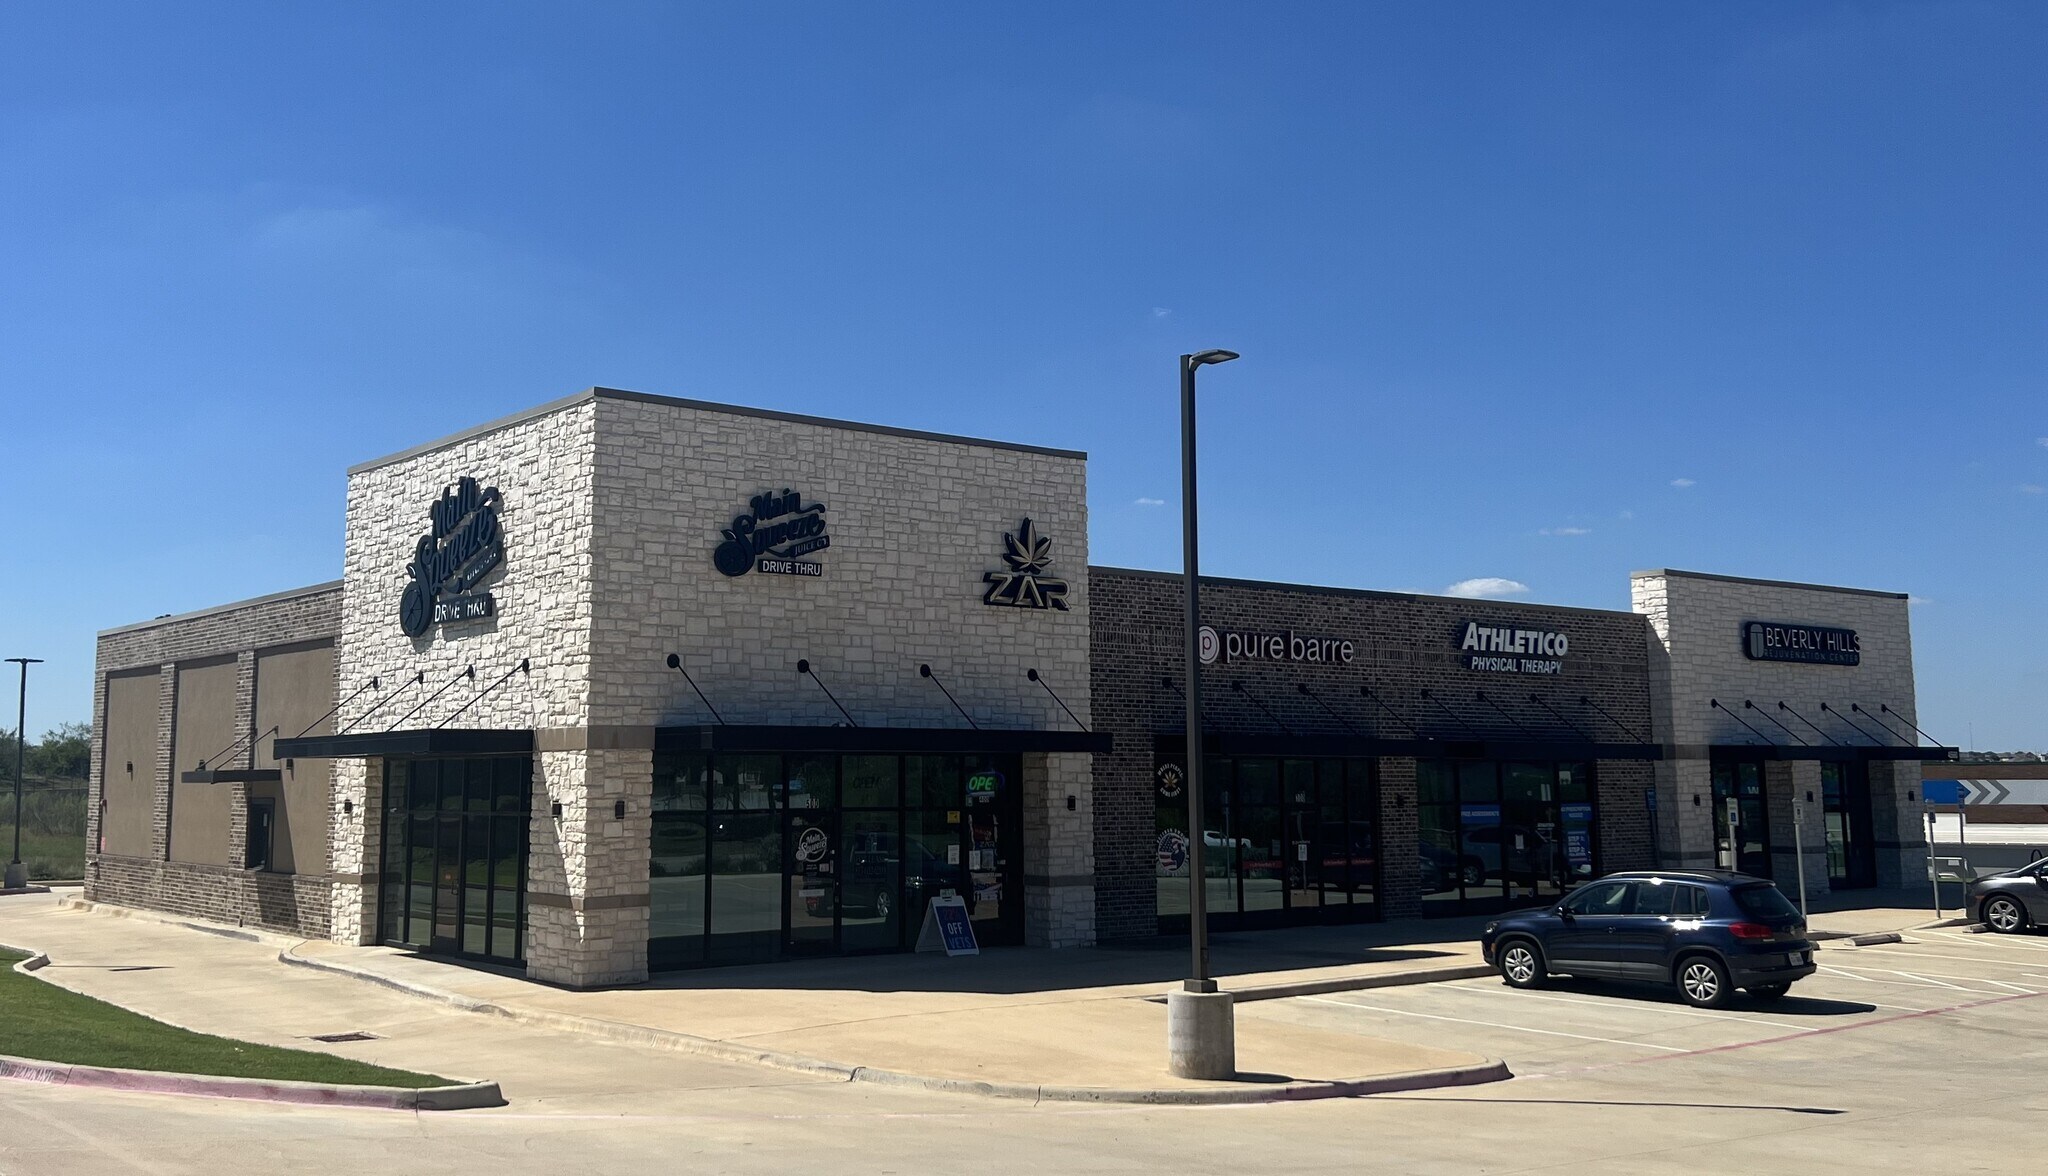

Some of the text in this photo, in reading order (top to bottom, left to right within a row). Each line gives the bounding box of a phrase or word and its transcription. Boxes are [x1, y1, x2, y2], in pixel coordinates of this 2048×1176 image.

[431, 476, 485, 538] Main
[750, 488, 806, 521] Main
[720, 513, 826, 566] Squeeze
[762, 560, 821, 576] DRIVE THRU
[985, 572, 1072, 611] ZAR
[434, 597, 487, 623] DRVE HRU
[1226, 632, 1285, 664] pure
[1290, 630, 1355, 663] barre
[1461, 622, 1569, 657] ATHLETICO
[1766, 627, 1860, 653] BEVERLY HILLS
[1471, 656, 1563, 675] PHYSICAL THERAPY
[969, 776, 997, 791] OPE
[947, 922, 963, 935] OFF
